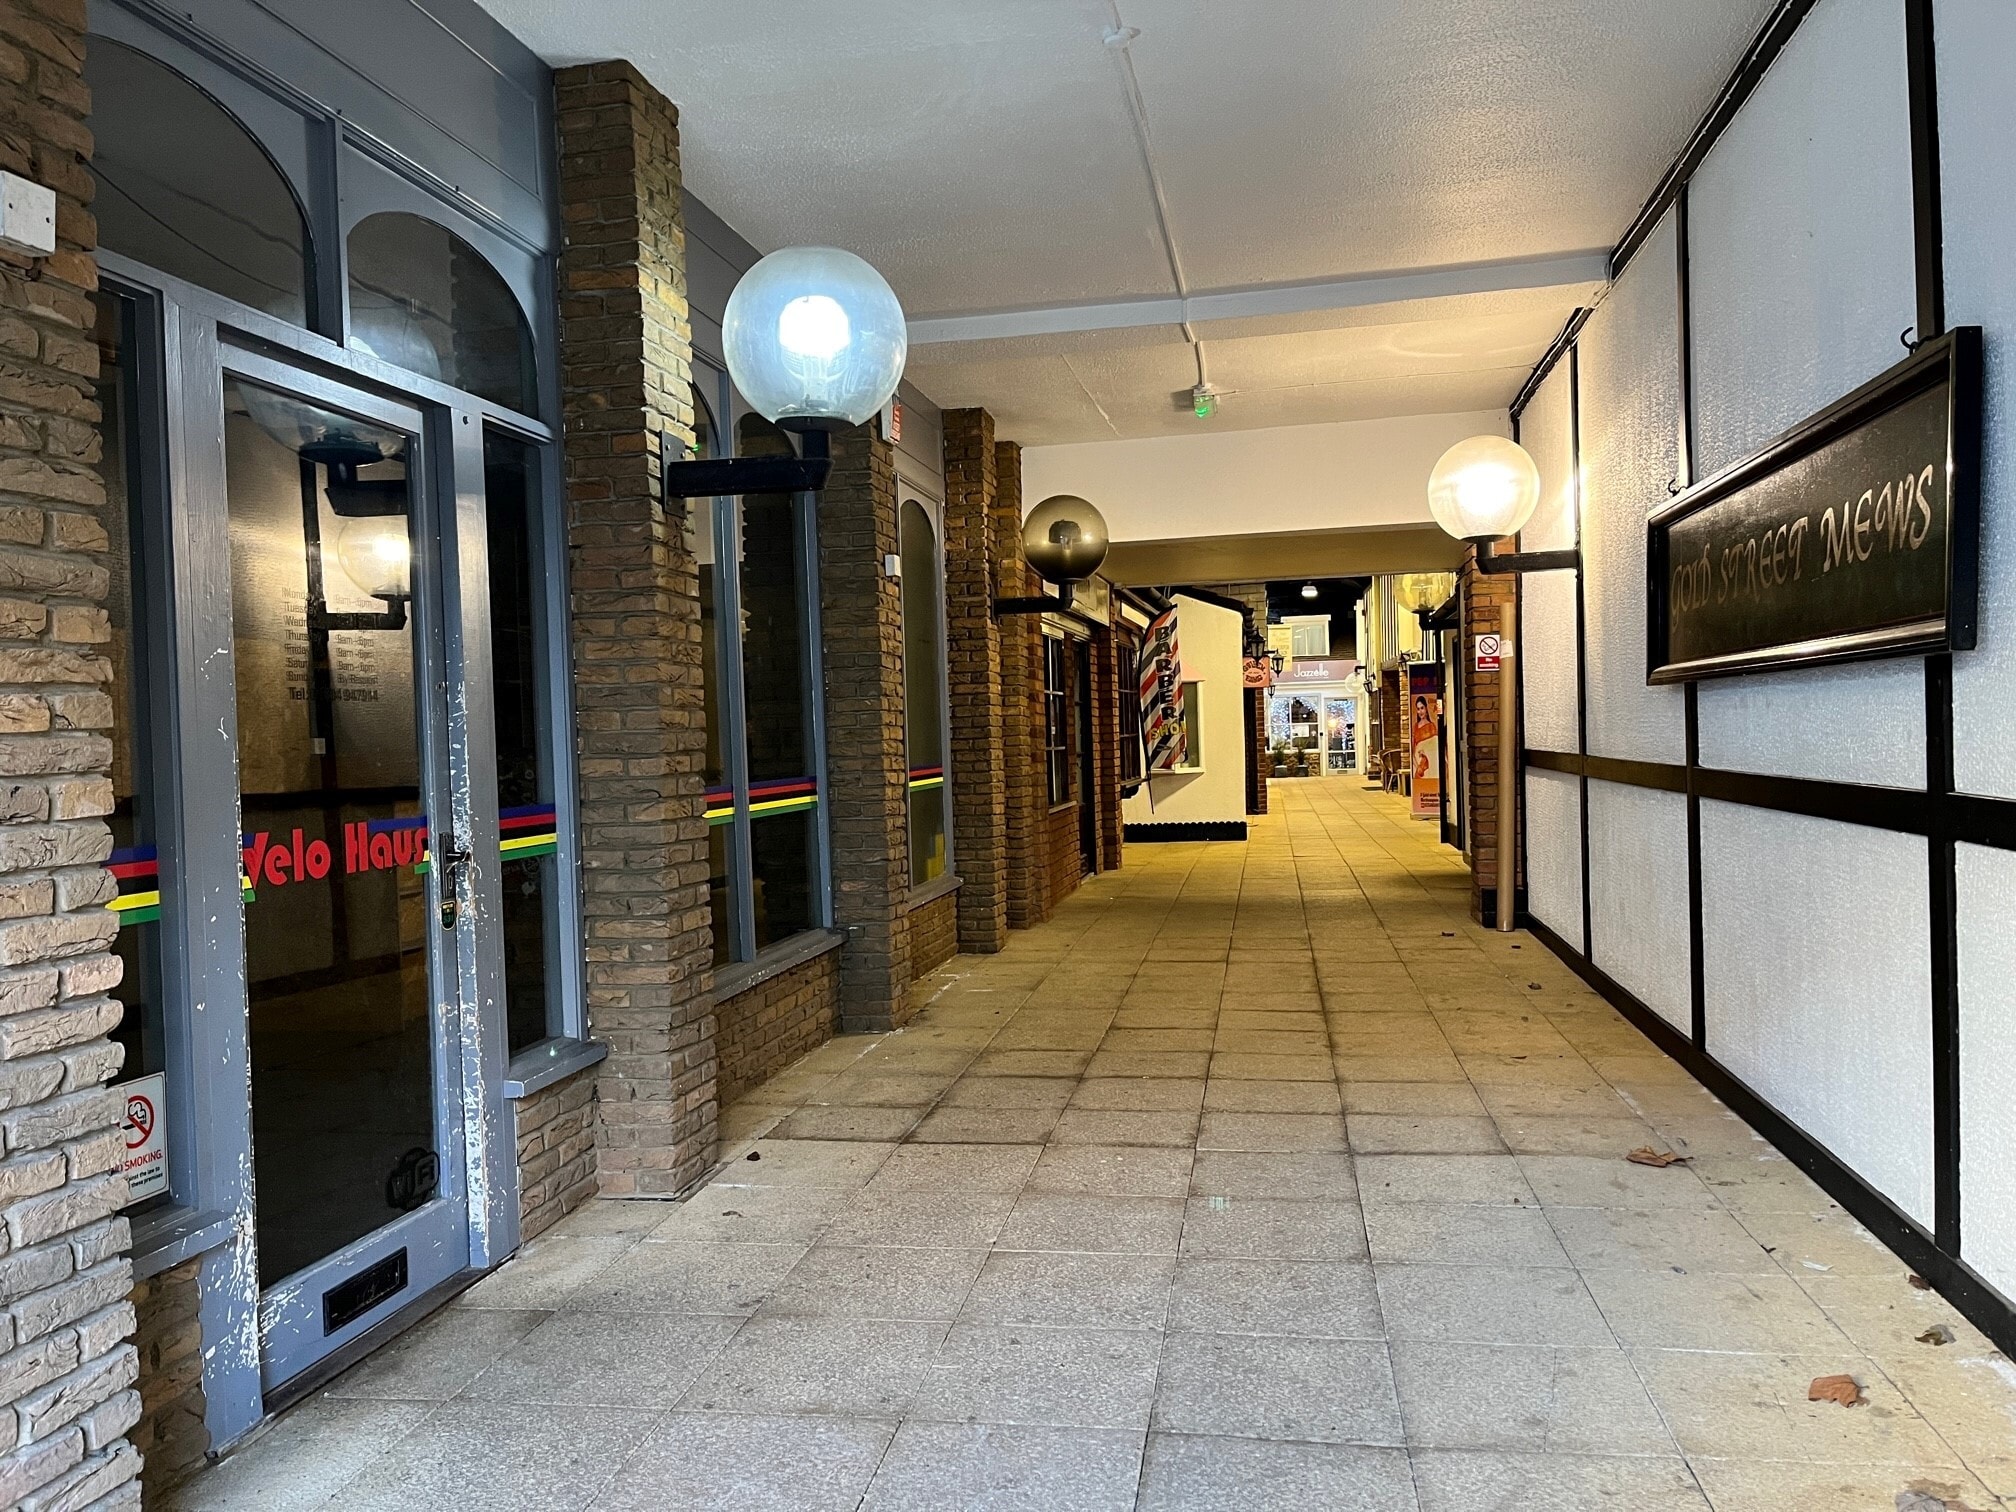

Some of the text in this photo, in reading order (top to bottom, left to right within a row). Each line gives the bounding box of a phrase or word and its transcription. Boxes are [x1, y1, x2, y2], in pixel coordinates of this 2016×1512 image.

[1670, 464, 1933, 632] GOLD STREET MEWS
[1154, 625, 1177, 721] BARBER
[1293, 663, 1329, 677] Jazzelle
[242, 821, 428, 890] Velo Haus
